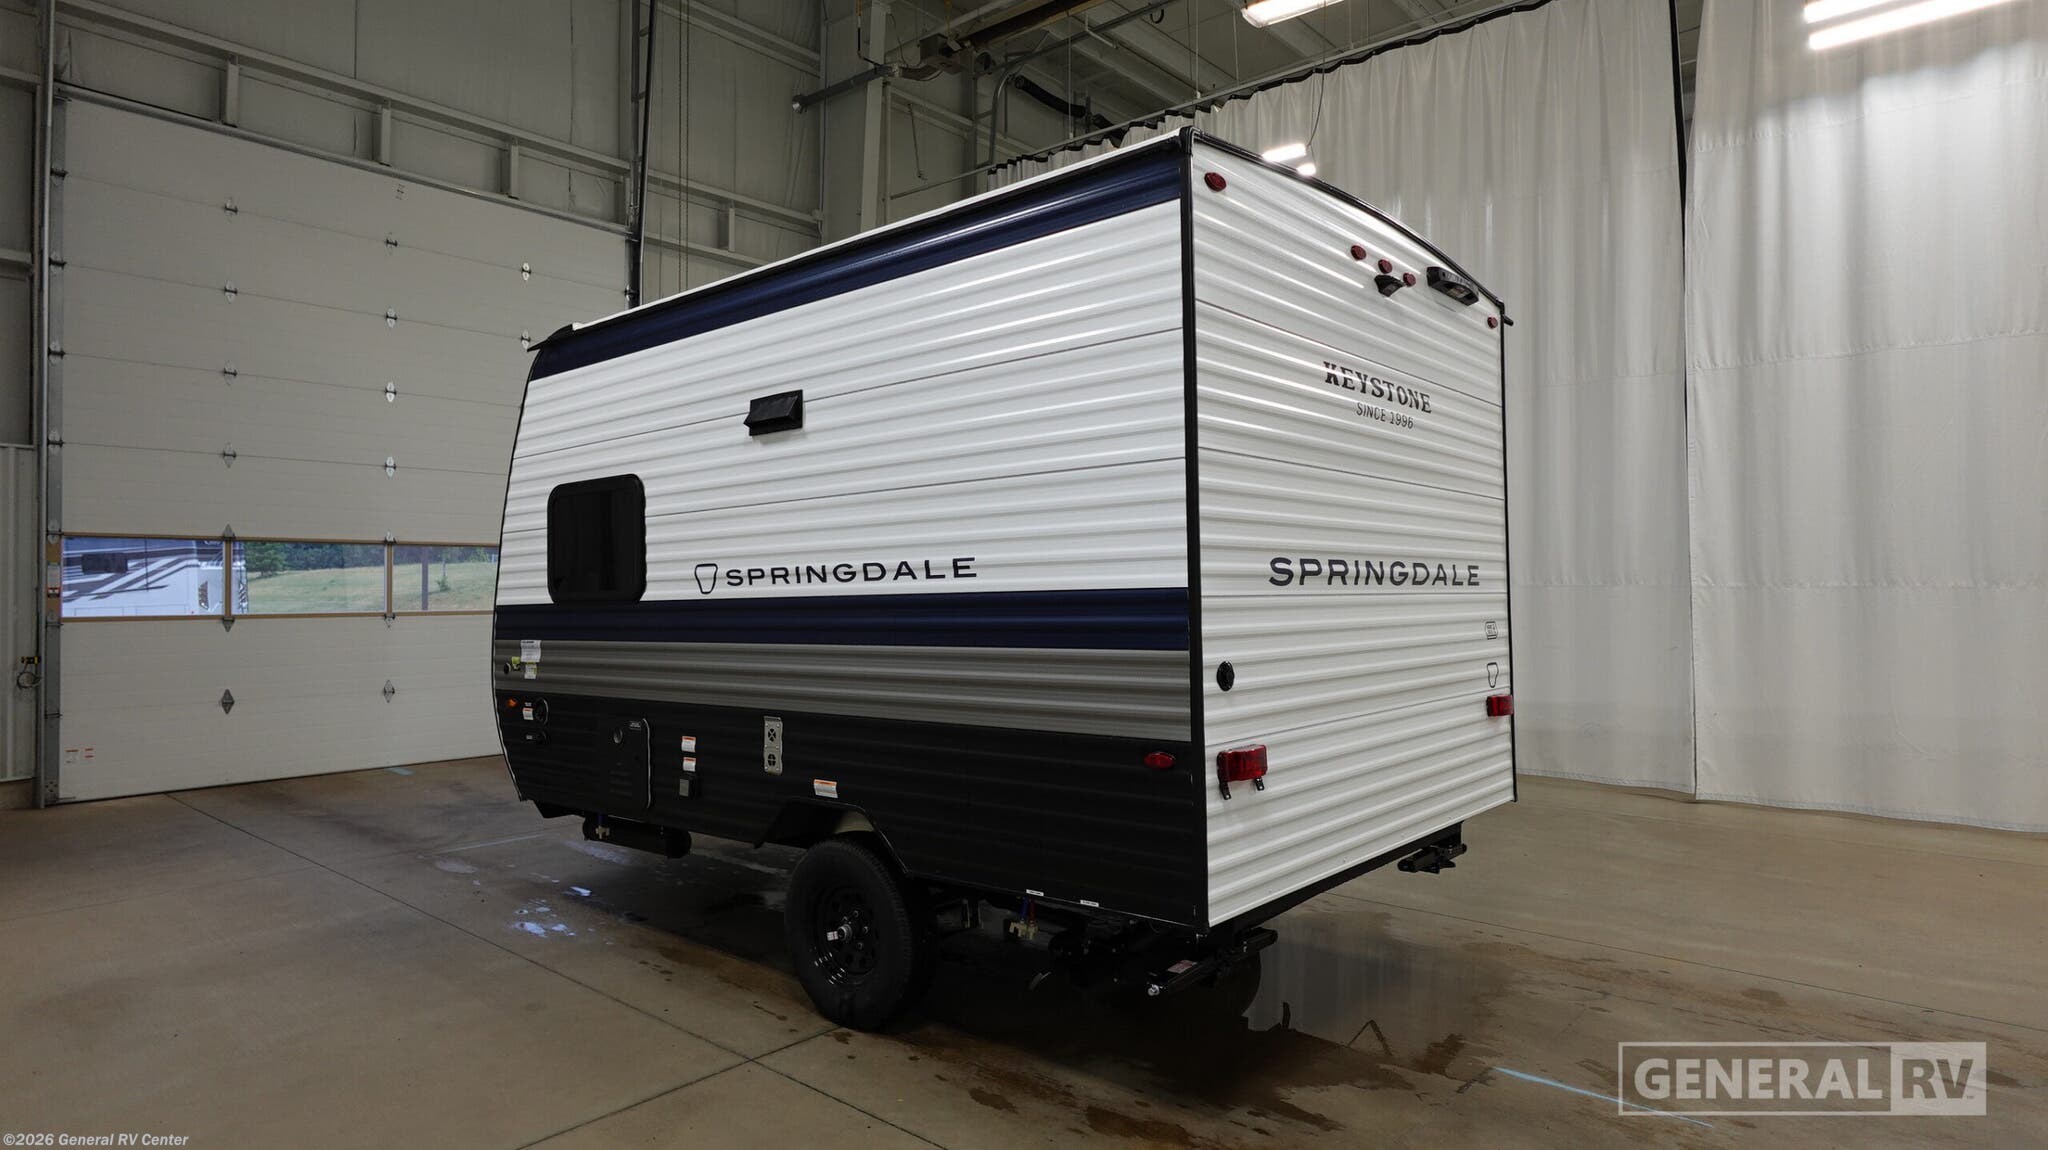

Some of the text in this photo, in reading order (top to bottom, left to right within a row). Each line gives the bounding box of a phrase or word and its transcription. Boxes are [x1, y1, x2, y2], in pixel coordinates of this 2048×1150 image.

[1323, 361, 1432, 413] KEYSTONE
[1356, 402, 1414, 429] SINCE 1996
[726, 557, 977, 586] SPRINGDALE
[1269, 557, 1480, 587] SPRINGDALE
